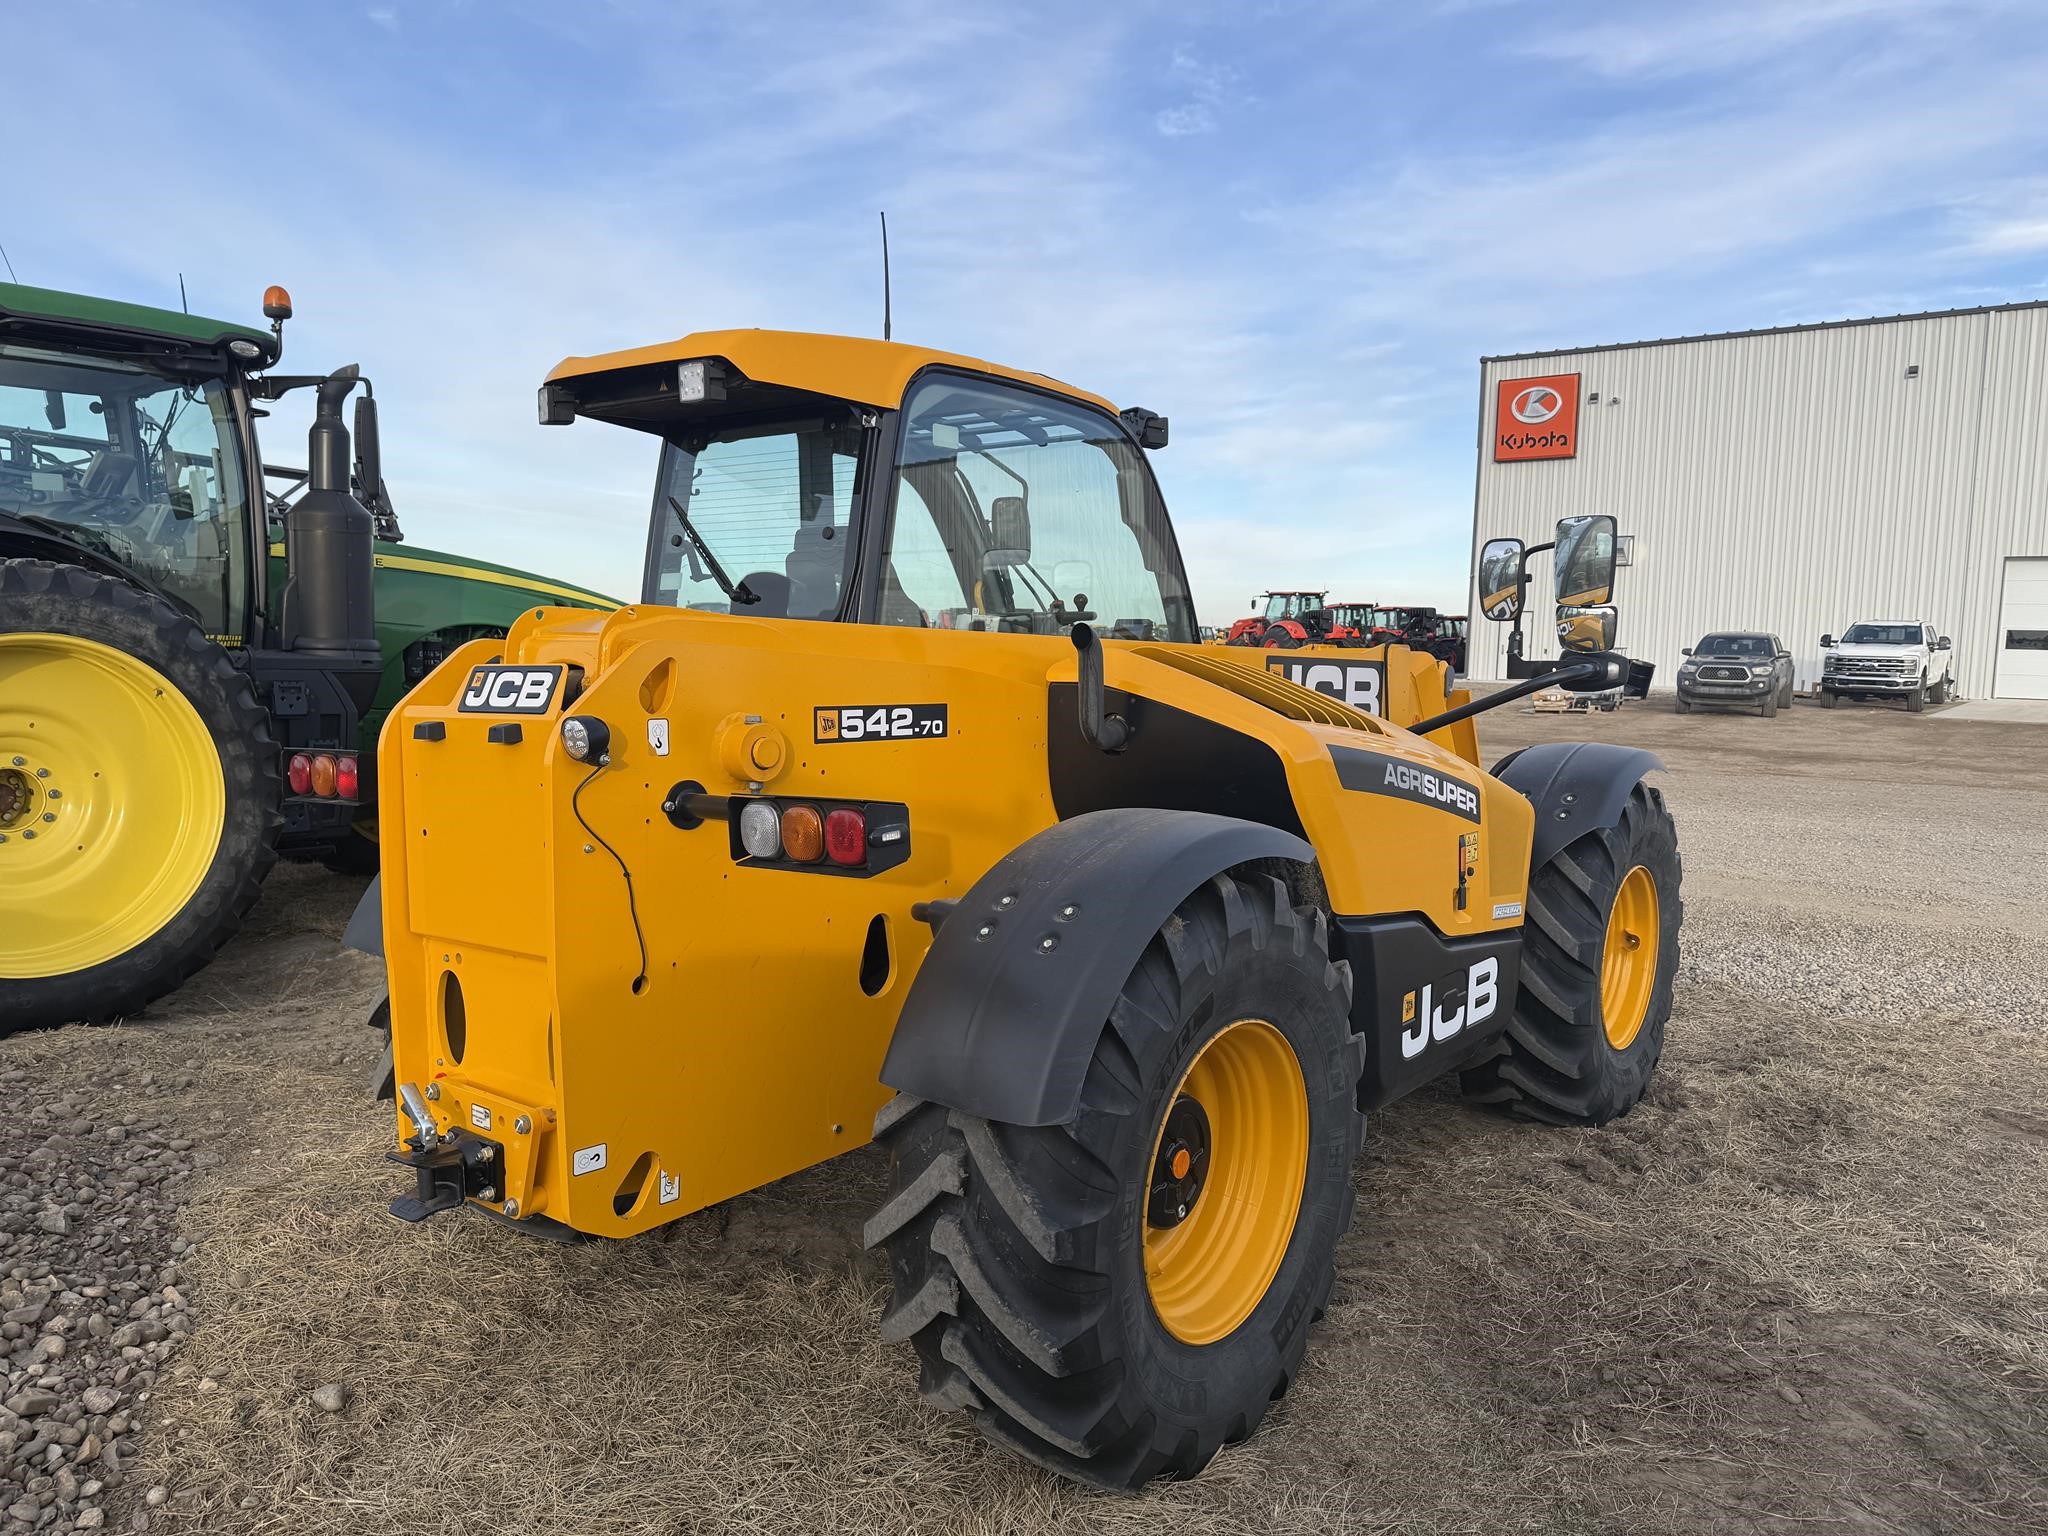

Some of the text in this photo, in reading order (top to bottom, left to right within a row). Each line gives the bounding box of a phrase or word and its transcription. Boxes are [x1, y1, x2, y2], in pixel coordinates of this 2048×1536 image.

[1500, 430, 1568, 450] Kubota
[464, 672, 554, 707] JCB
[1383, 762, 1478, 815] AGRISUPER
[1401, 956, 1499, 1059] JCB
